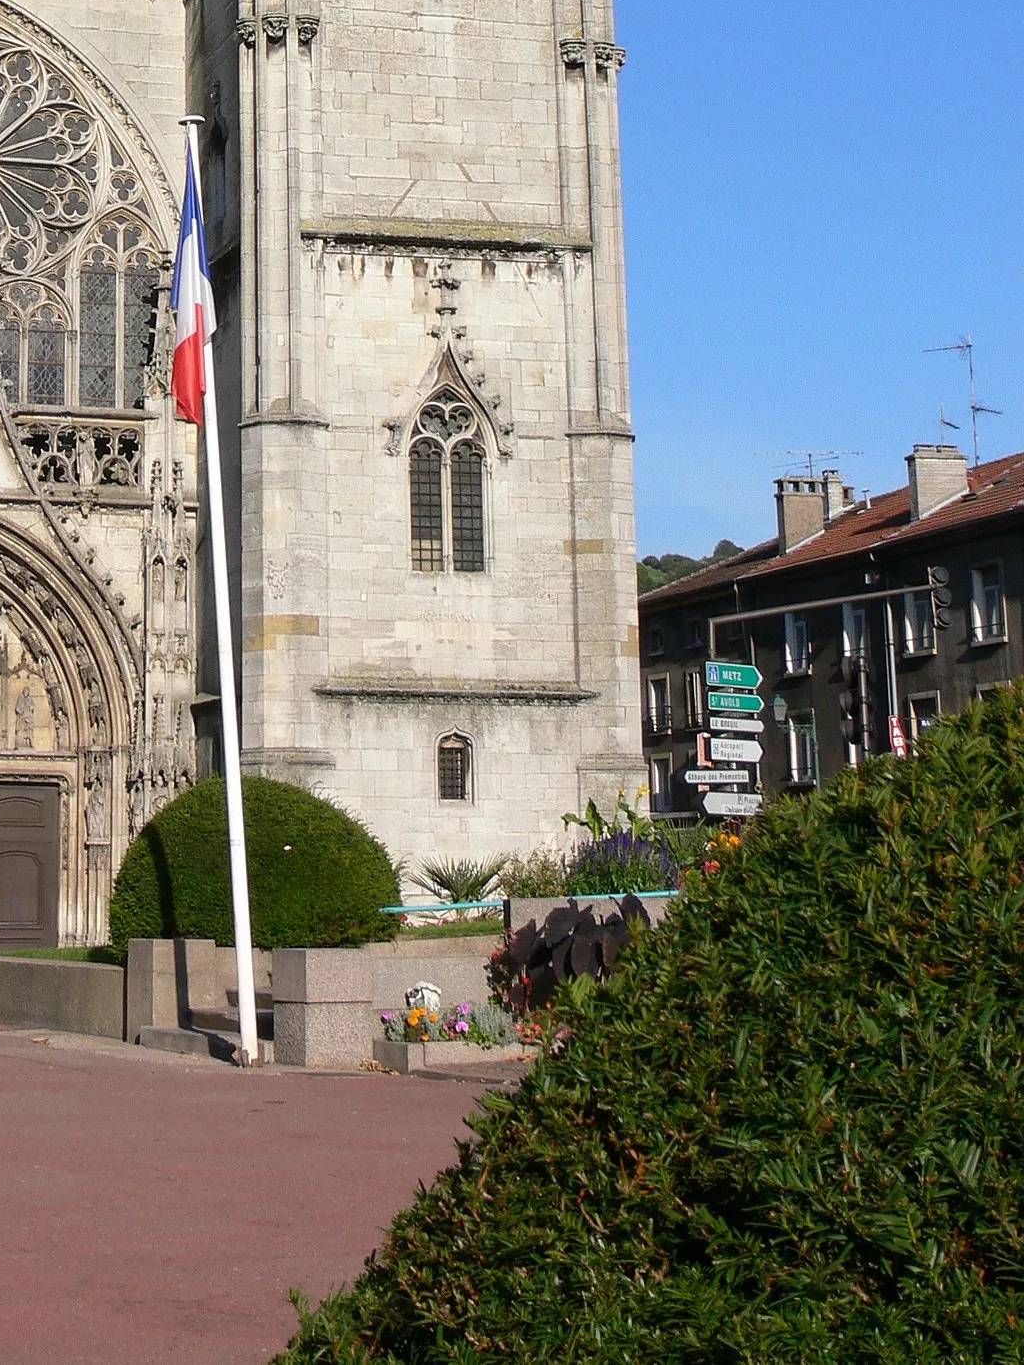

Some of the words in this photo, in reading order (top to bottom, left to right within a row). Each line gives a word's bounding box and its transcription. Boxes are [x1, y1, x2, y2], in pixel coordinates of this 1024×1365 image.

[722, 670, 742, 681] METZ
[720, 696, 740, 707] AVOLD
[712, 719, 718, 727] LE
[687, 772, 706, 781] Abbaye
[709, 772, 718, 780] des
